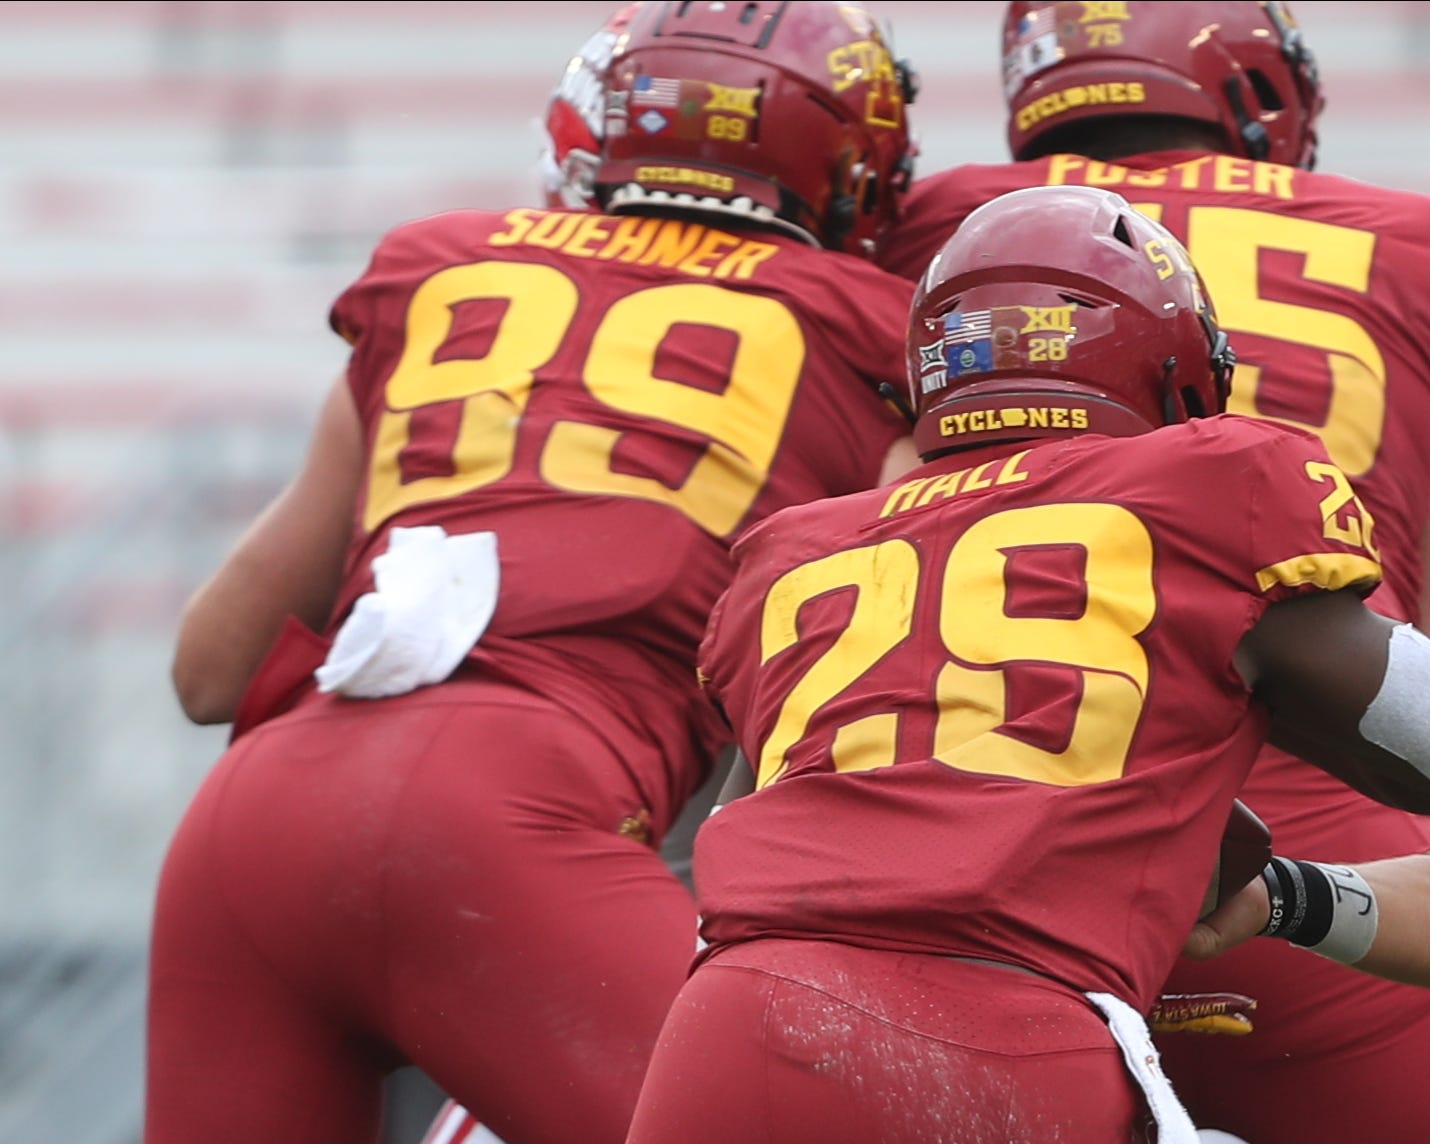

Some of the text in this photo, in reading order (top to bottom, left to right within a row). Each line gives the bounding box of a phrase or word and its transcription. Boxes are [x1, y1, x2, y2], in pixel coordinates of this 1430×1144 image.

[1085, 23, 1123, 48] 75
[707, 115, 746, 142] 89
[1016, 82, 1146, 130] CYCLONES
[1046, 153, 1296, 200] FOSTER
[488, 208, 780, 280] SOEHNER
[1020, 303, 1079, 335] XII
[1130, 203, 1386, 477] 5
[1027, 337, 1068, 362] 28
[363, 259, 806, 538] 89
[940, 407, 1088, 437] CYCLONES
[879, 449, 1033, 519] HALL
[755, 502, 1155, 791] 28
